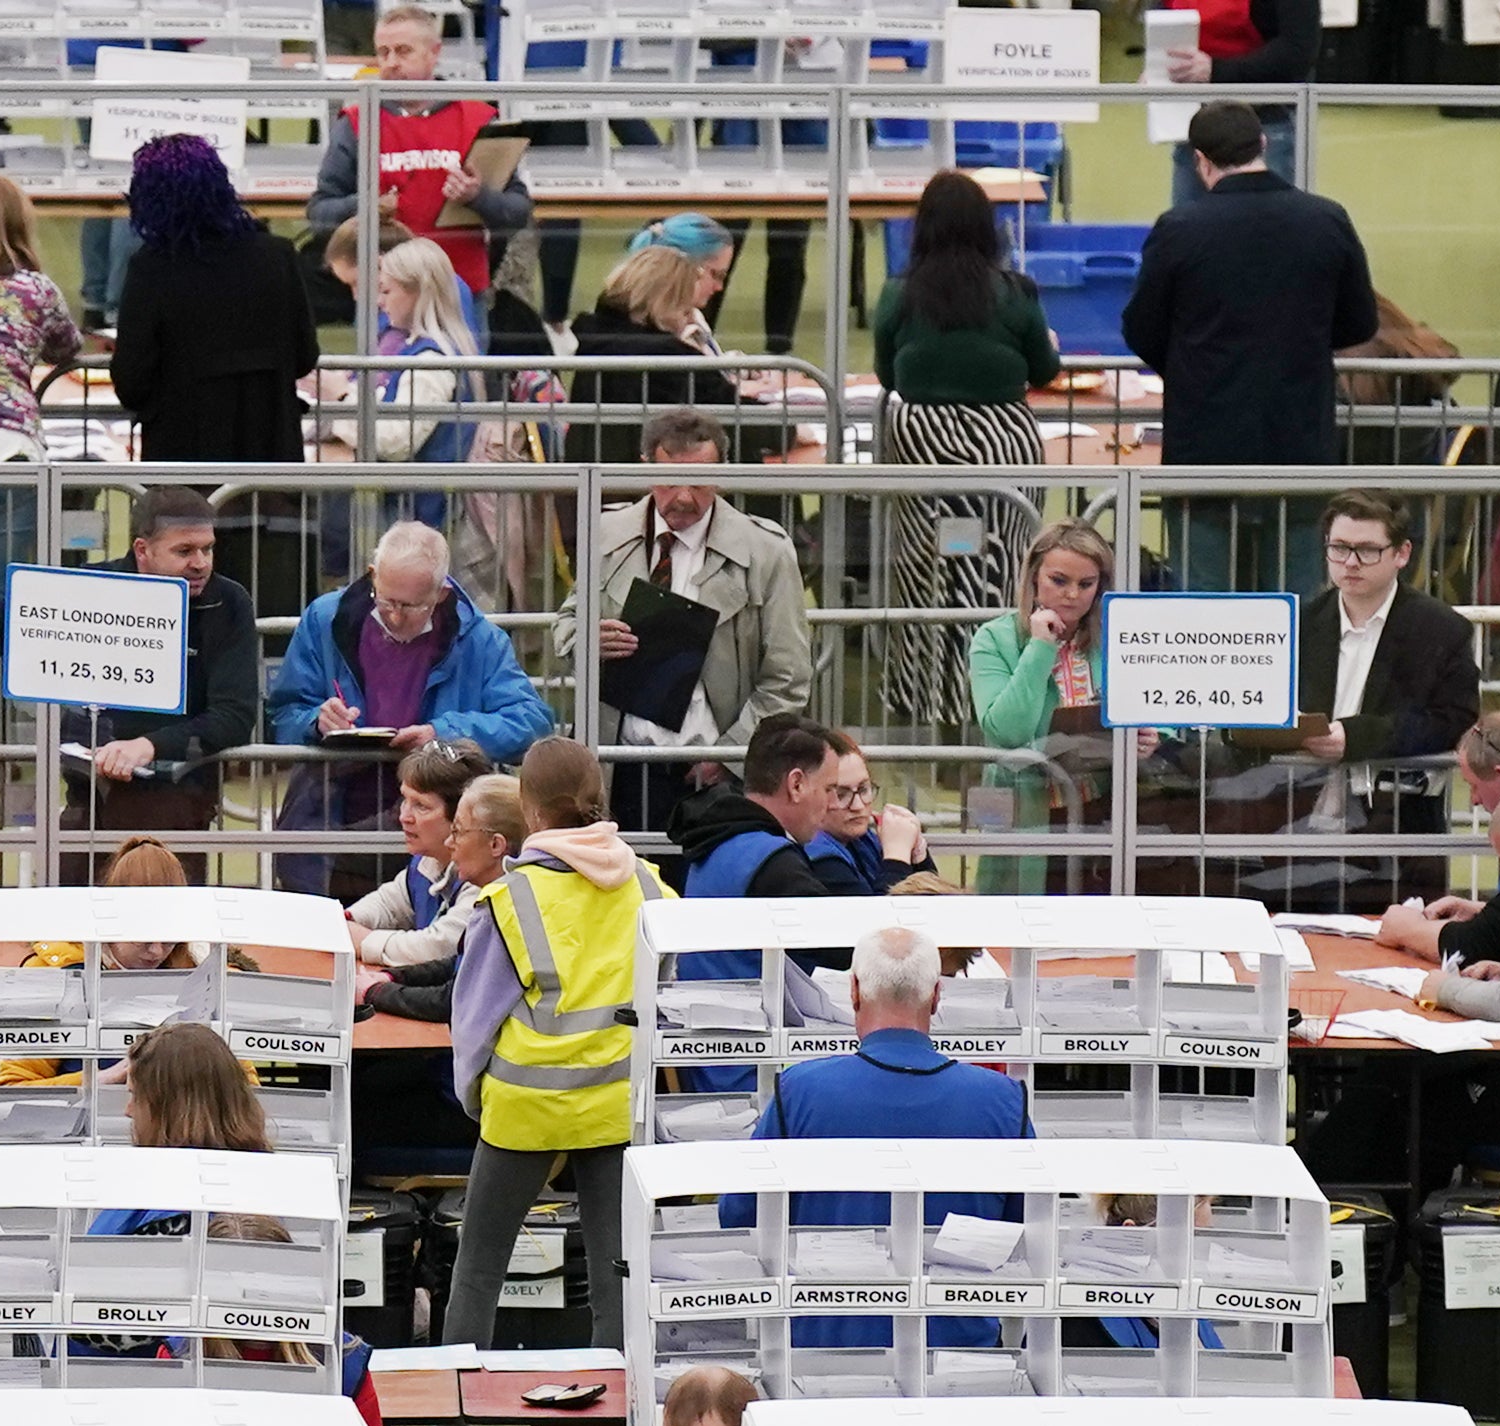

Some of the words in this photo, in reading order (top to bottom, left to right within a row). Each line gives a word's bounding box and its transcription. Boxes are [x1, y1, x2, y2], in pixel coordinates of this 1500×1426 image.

[994, 43, 1052, 58] FOYLE
[108, 108, 181, 120] VERIFICATION
[20, 605, 57, 619] EAST
[62, 610, 177, 630] LONDONDERRY
[21, 628, 101, 644] VERIFICATION
[104, 635, 120, 645] OF
[124, 636, 164, 650] BOXES
[1120, 633, 1160, 644] EAST
[1166, 633, 1287, 645] LONDONDERRY
[1121, 655, 1207, 665] VERIFICATION
[1211, 656, 1227, 664] OF
[1231, 656, 1273, 665] BOXES
[40, 660, 64, 677] 11,
[70, 663, 95, 681] 25,
[102, 666, 127, 683] 39,
[134, 668, 154, 683] 53
[1143, 690, 1168, 707] 12,
[1176, 691, 1202, 708] 26,
[1209, 691, 1235, 708] 40,
[1242, 691, 1263, 704] 54
[246, 1034, 328, 1052] COULSON
[671, 1042, 765, 1053] ARCHIBALD
[1065, 1040, 1128, 1050] BROLLY
[1181, 1039, 1262, 1057] COULSON
[504, 1285, 543, 1296] 53/ELY
[670, 1292, 771, 1308] ARCHIBALD
[795, 1291, 907, 1302] ARMSTRONG
[945, 1290, 1027, 1302] BRADLEY
[1086, 1291, 1154, 1304] BROLLY
[1216, 1292, 1303, 1311] COULSON
[98, 1309, 167, 1321] BROLLY
[221, 1313, 309, 1329] COULSON
